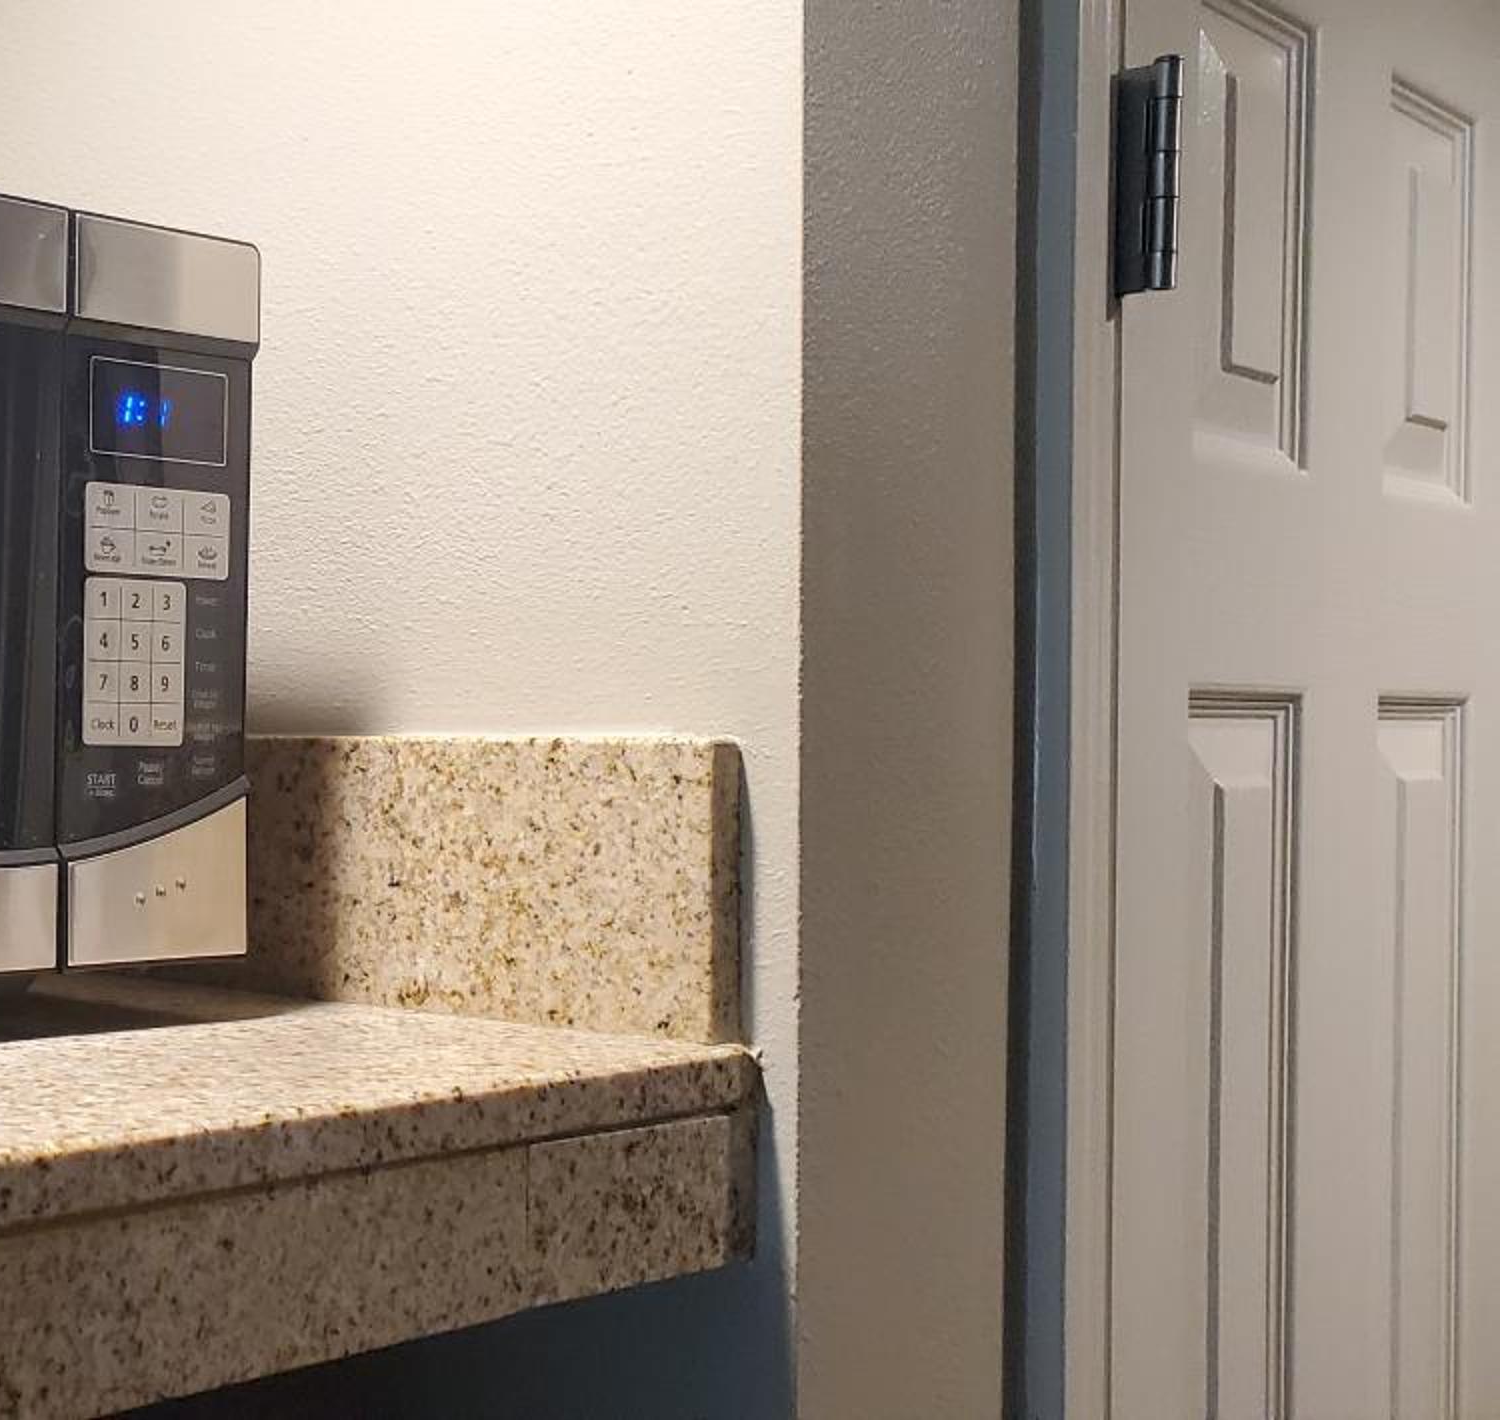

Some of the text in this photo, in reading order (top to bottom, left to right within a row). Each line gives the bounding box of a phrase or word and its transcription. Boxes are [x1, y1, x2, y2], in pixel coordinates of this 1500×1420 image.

[99, 591, 108, 608] 1
[131, 593, 141, 609] 2
[163, 594, 172, 611] 3
[99, 632, 108, 649] 4
[131, 633, 140, 650] 5
[161, 635, 171, 652] 6
[99, 674, 109, 691] 7
[130, 675, 140, 692] 8
[161, 675, 170, 692] 9
[91, 718, 116, 731] Clock
[129, 717, 139, 733] 0
[153, 719, 178, 731] Reset
[86, 773, 117, 786] START
